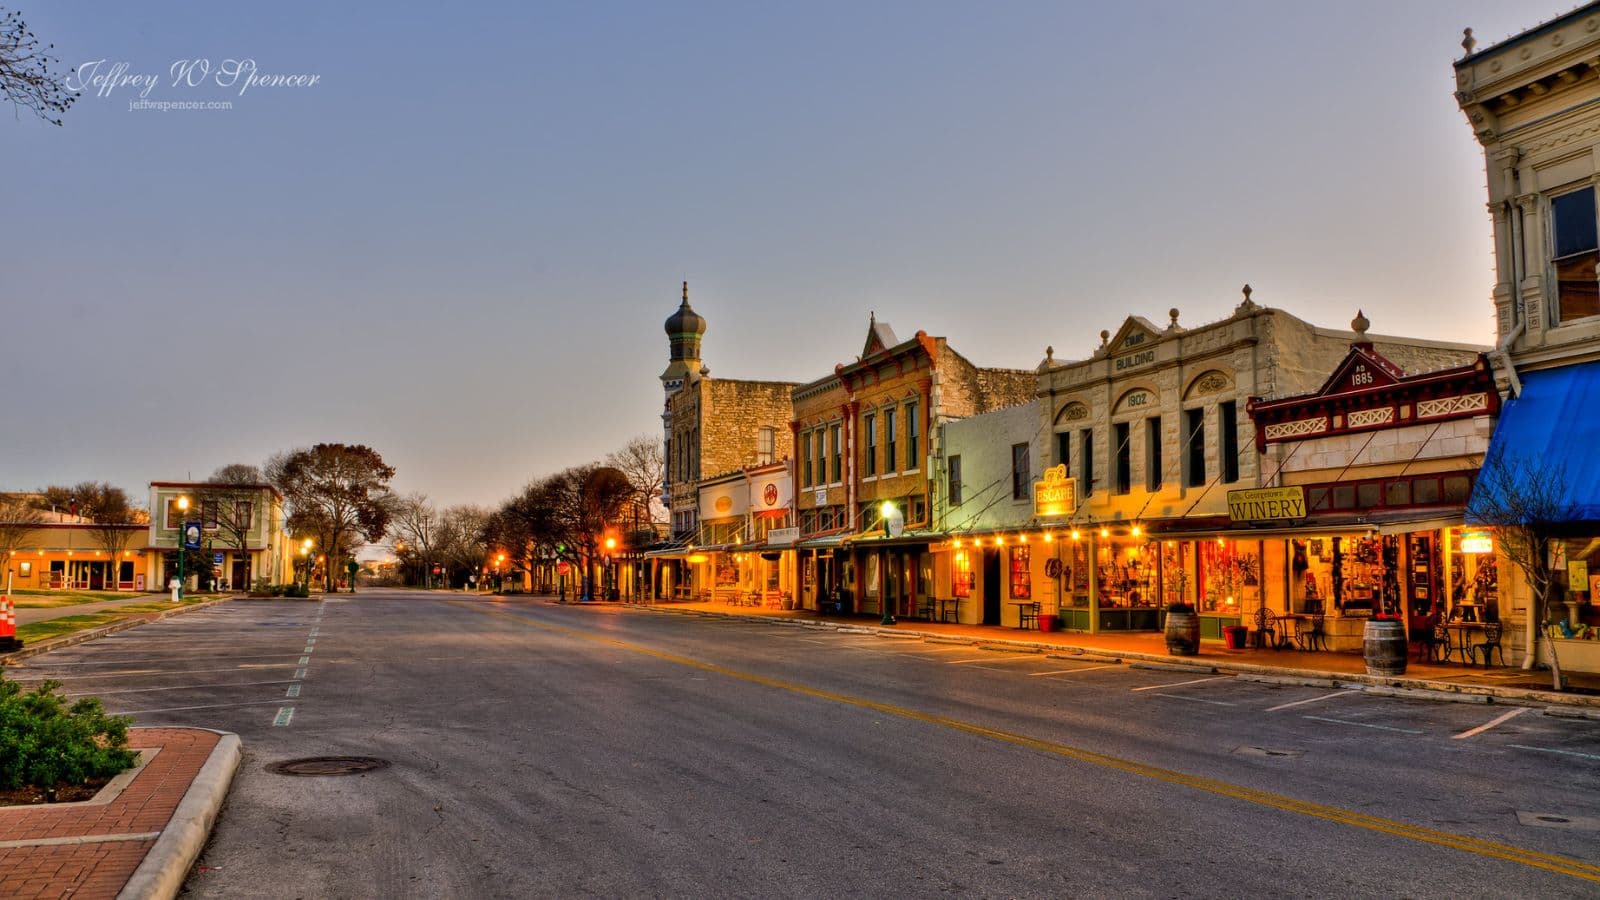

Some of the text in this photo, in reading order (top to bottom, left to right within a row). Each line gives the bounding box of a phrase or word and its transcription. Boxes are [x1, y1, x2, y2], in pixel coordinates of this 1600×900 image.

[1116, 351, 1154, 370] BUILDING
[1352, 372, 1373, 386] 1885
[1036, 487, 1073, 503] ESCAPE
[1244, 490, 1284, 500] Georgetown
[1230, 498, 1303, 520] WINERY
